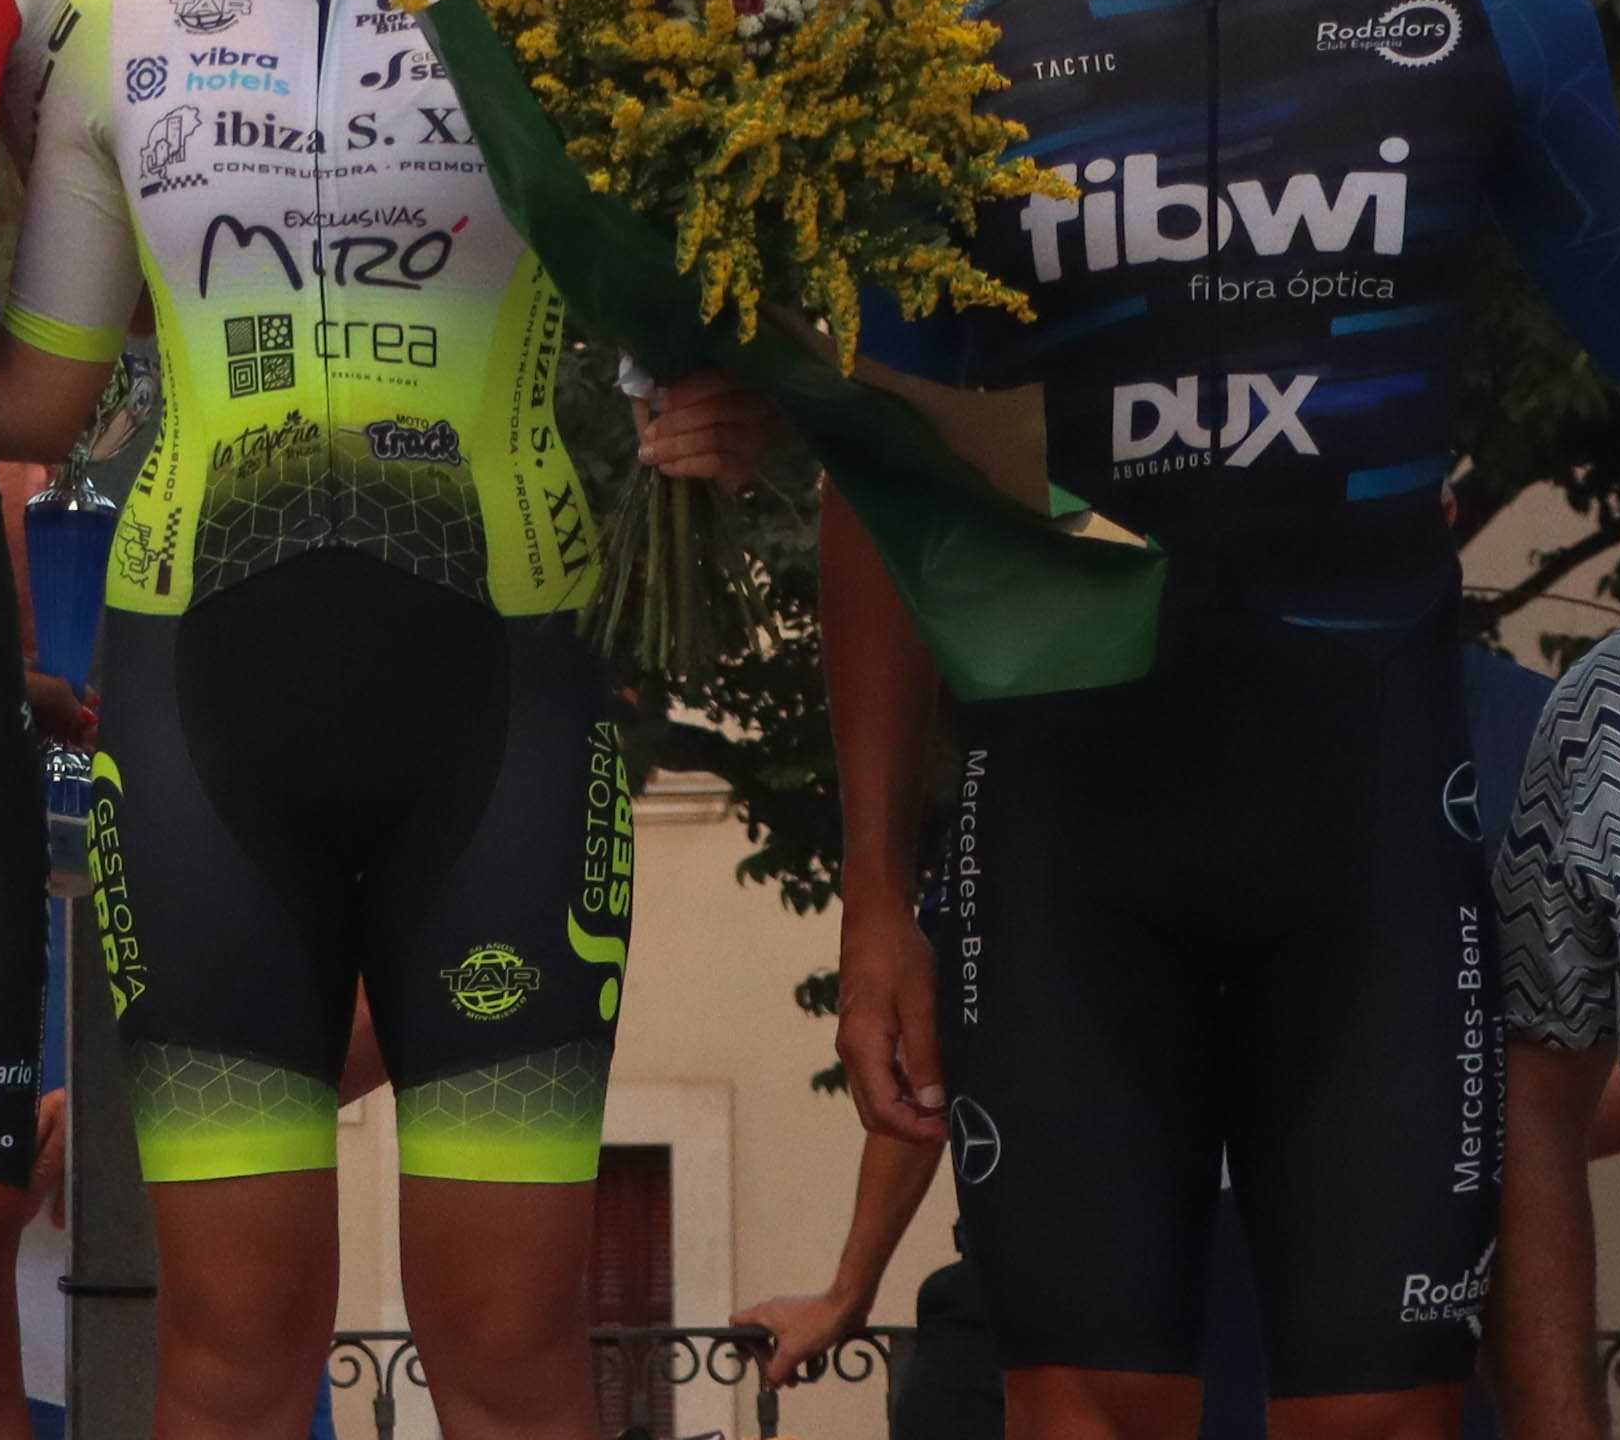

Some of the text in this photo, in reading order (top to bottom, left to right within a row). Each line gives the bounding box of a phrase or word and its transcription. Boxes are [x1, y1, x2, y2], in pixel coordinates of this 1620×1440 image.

[1316, 16, 1446, 42] Rodadors
[189, 46, 279, 71] vibra
[1033, 53, 1118, 81] TACTIC
[186, 68, 291, 97] hotels
[213, 110, 327, 155] ibiza
[347, 112, 395, 152] S.
[213, 161, 378, 180] CONSTRUCTORA
[283, 206, 428, 229] EXCLUSIVAS
[1019, 135, 1411, 284] fibwi
[1187, 268, 1396, 305] fibra óptica
[314, 320, 437, 368] crea
[395, 413, 430, 430] MOTO
[1111, 372, 1321, 468] DUX
[530, 425, 557, 469] S.
[1111, 450, 1212, 482] ABOGADOS
[513, 473, 545, 589] PROMOTORA
[582, 719, 620, 913] GESTORÍA
[97, 797, 146, 1004] GESTORÍA
[959, 748, 989, 1025] Mercedes-Benz
[1451, 903, 1484, 1194] Mercedes-Benz
[1400, 1306, 1440, 1323] Club
